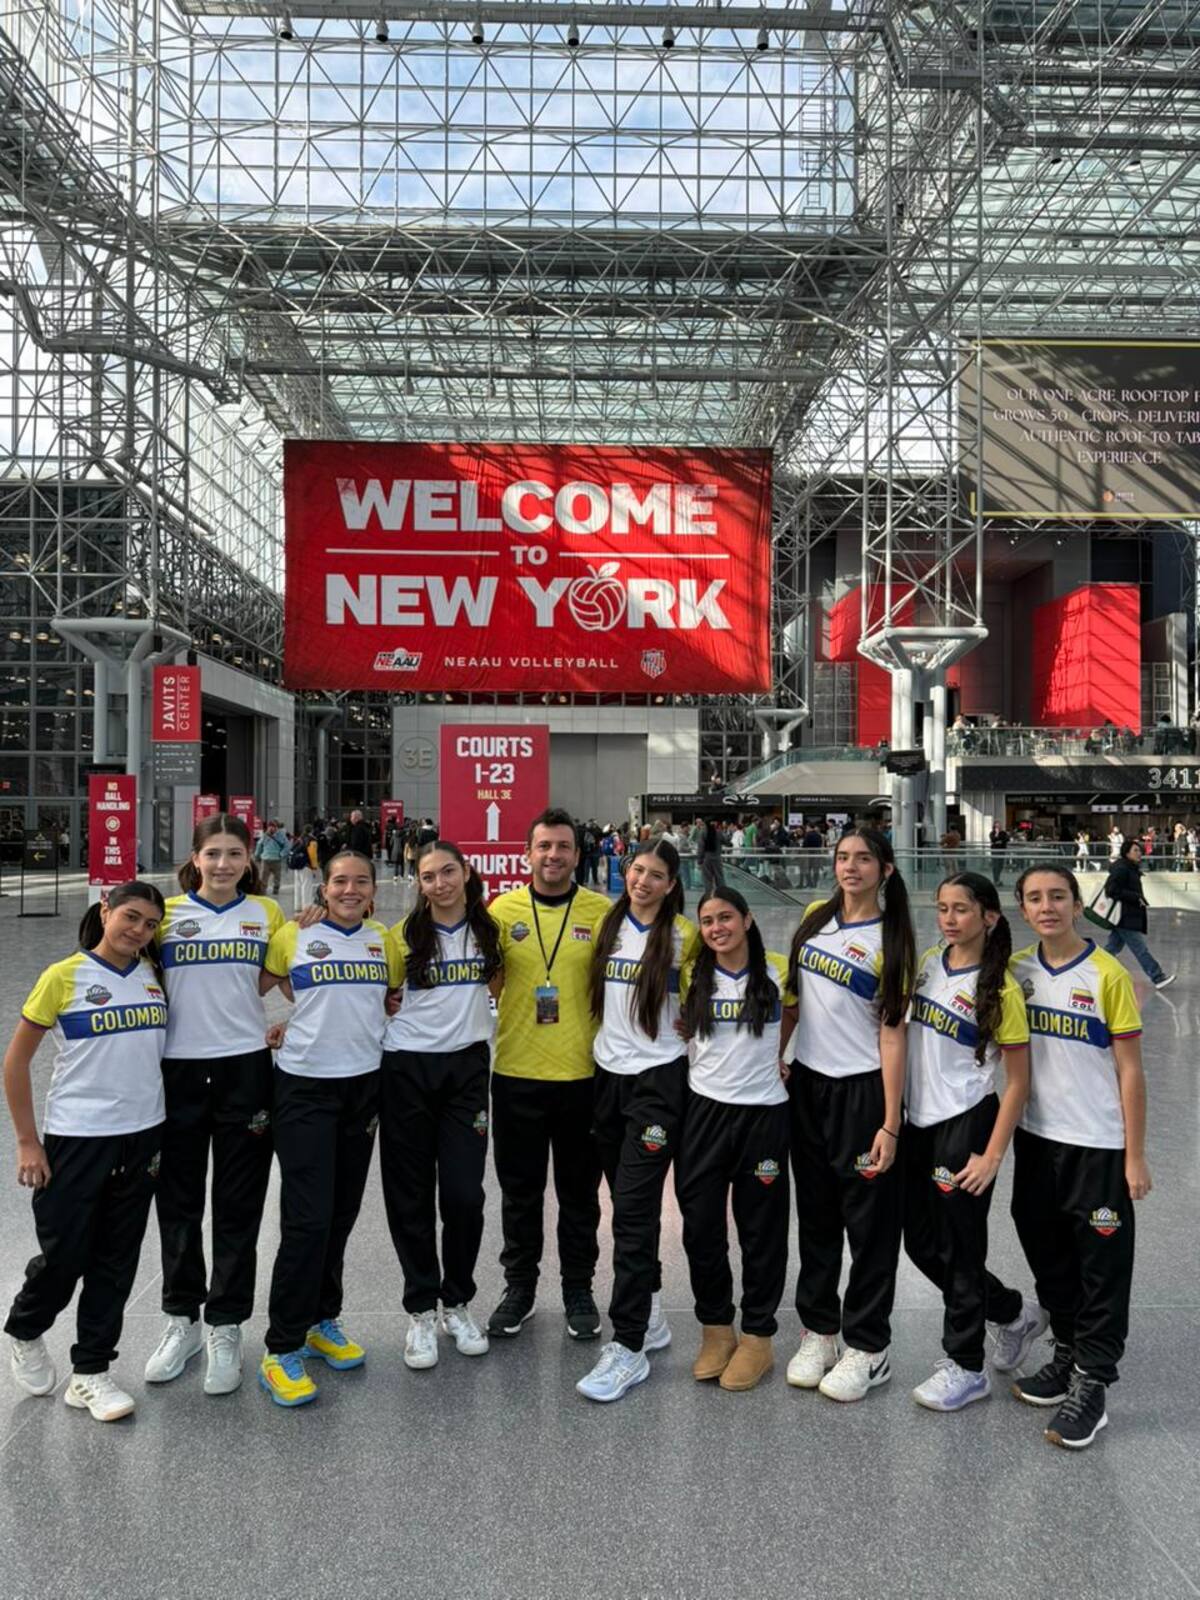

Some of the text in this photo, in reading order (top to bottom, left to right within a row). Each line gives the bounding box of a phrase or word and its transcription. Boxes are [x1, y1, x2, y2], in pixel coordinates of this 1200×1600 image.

[1007, 388, 1038, 401] OUR
[1043, 389, 1073, 402] ONE
[1080, 389, 1116, 402] ACRE
[1122, 389, 1190, 403] ROOFTOP
[993, 408, 1046, 422] GROWS
[1020, 430, 1101, 443] AUTHENTIC
[1106, 430, 1144, 444] ROOF
[1152, 431, 1171, 444] TO
[1077, 451, 1162, 465] EXPERIENCE
[336, 478, 718, 535] WELCOME
[510, 545, 548, 565] TO
[326, 570, 732, 631] NEW YORK
[444, 656, 619, 669] NEAAU VOLLEYBALL
[162, 676, 176, 730] JAVITS
[180, 676, 190, 731] CENTER
[457, 736, 533, 757] COURTS
[404, 747, 433, 769] 3E
[475, 763, 515, 784] 1-23
[107, 782, 118, 791] NO
[477, 789, 512, 800] HALL 3E
[104, 791, 121, 801] BALL
[96, 801, 131, 811] HANDLING
[109, 836, 118, 845] IN
[104, 846, 121, 855] THIS
[104, 855, 122, 865] AREA
[175, 941, 261, 963] COLOMBIA
[798, 945, 853, 986] LOMBIA
[916, 1002, 960, 1039] LOMBIA
[1030, 1008, 1091, 1041] LOMBIA
